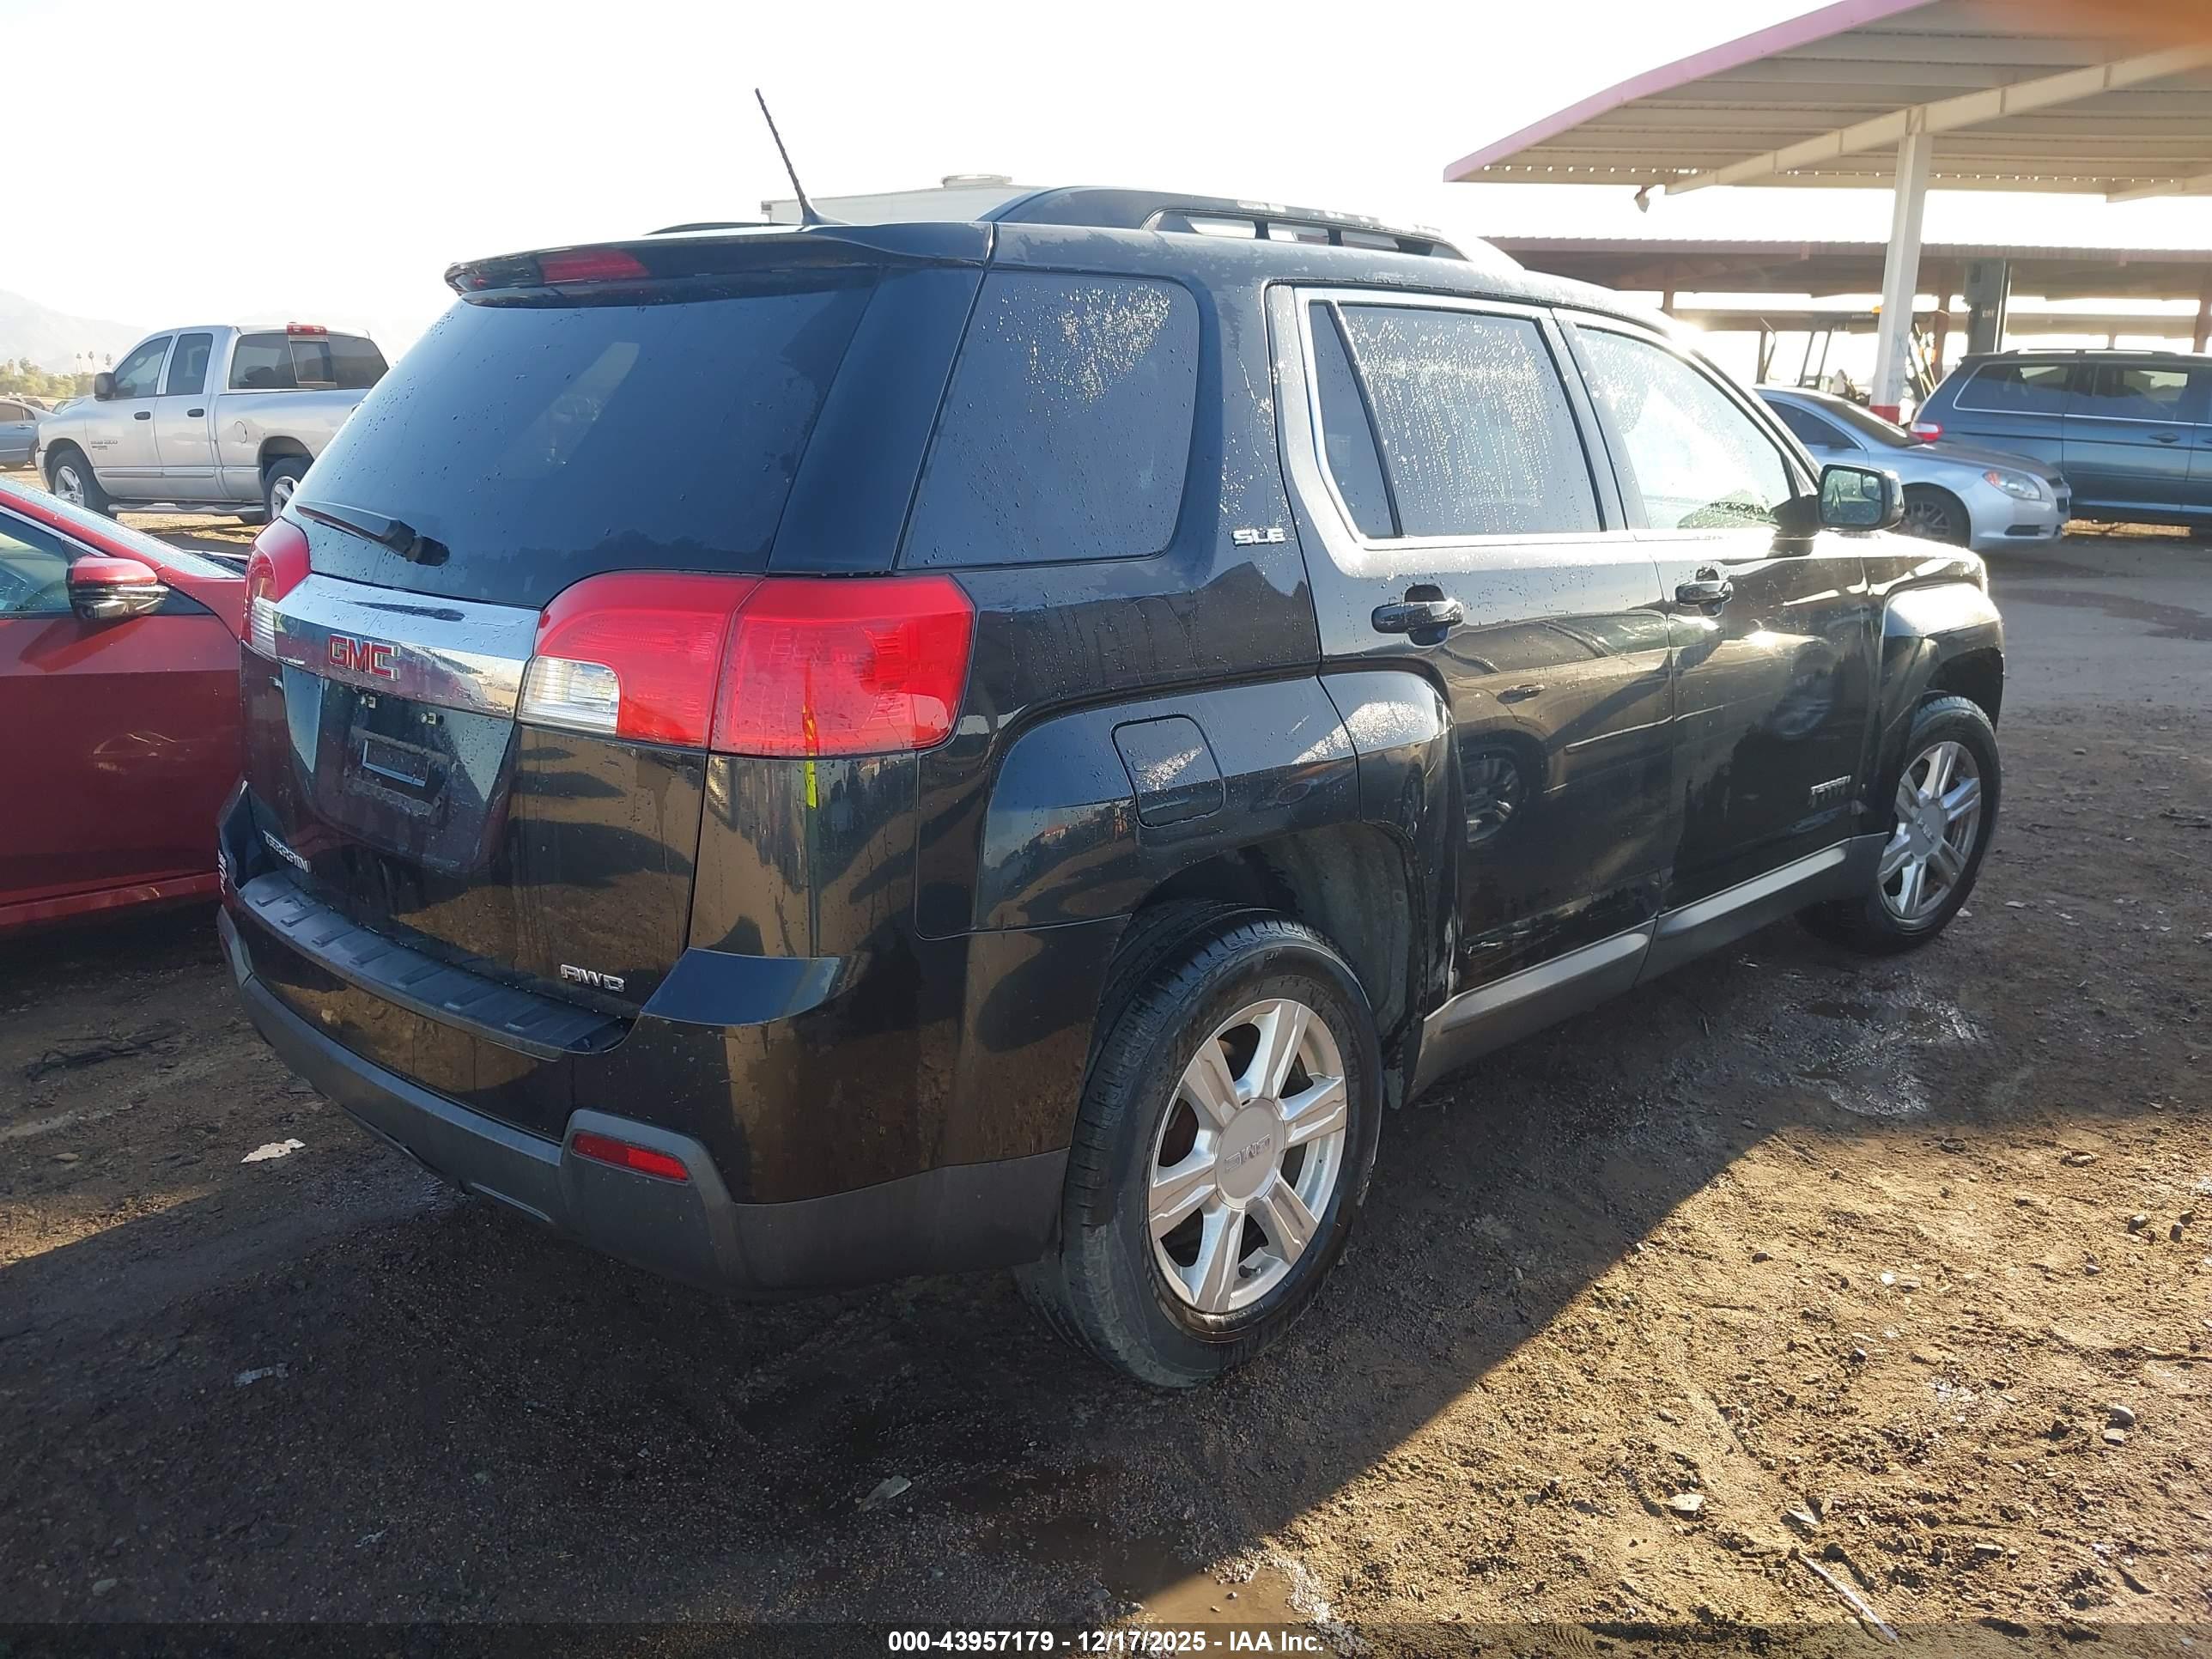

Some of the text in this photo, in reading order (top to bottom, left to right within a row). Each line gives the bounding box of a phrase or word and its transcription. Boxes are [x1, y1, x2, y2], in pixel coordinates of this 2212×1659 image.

[1232, 528, 1285, 545] SLE
[329, 633, 400, 681] GMC
[561, 963, 625, 992] AWD
